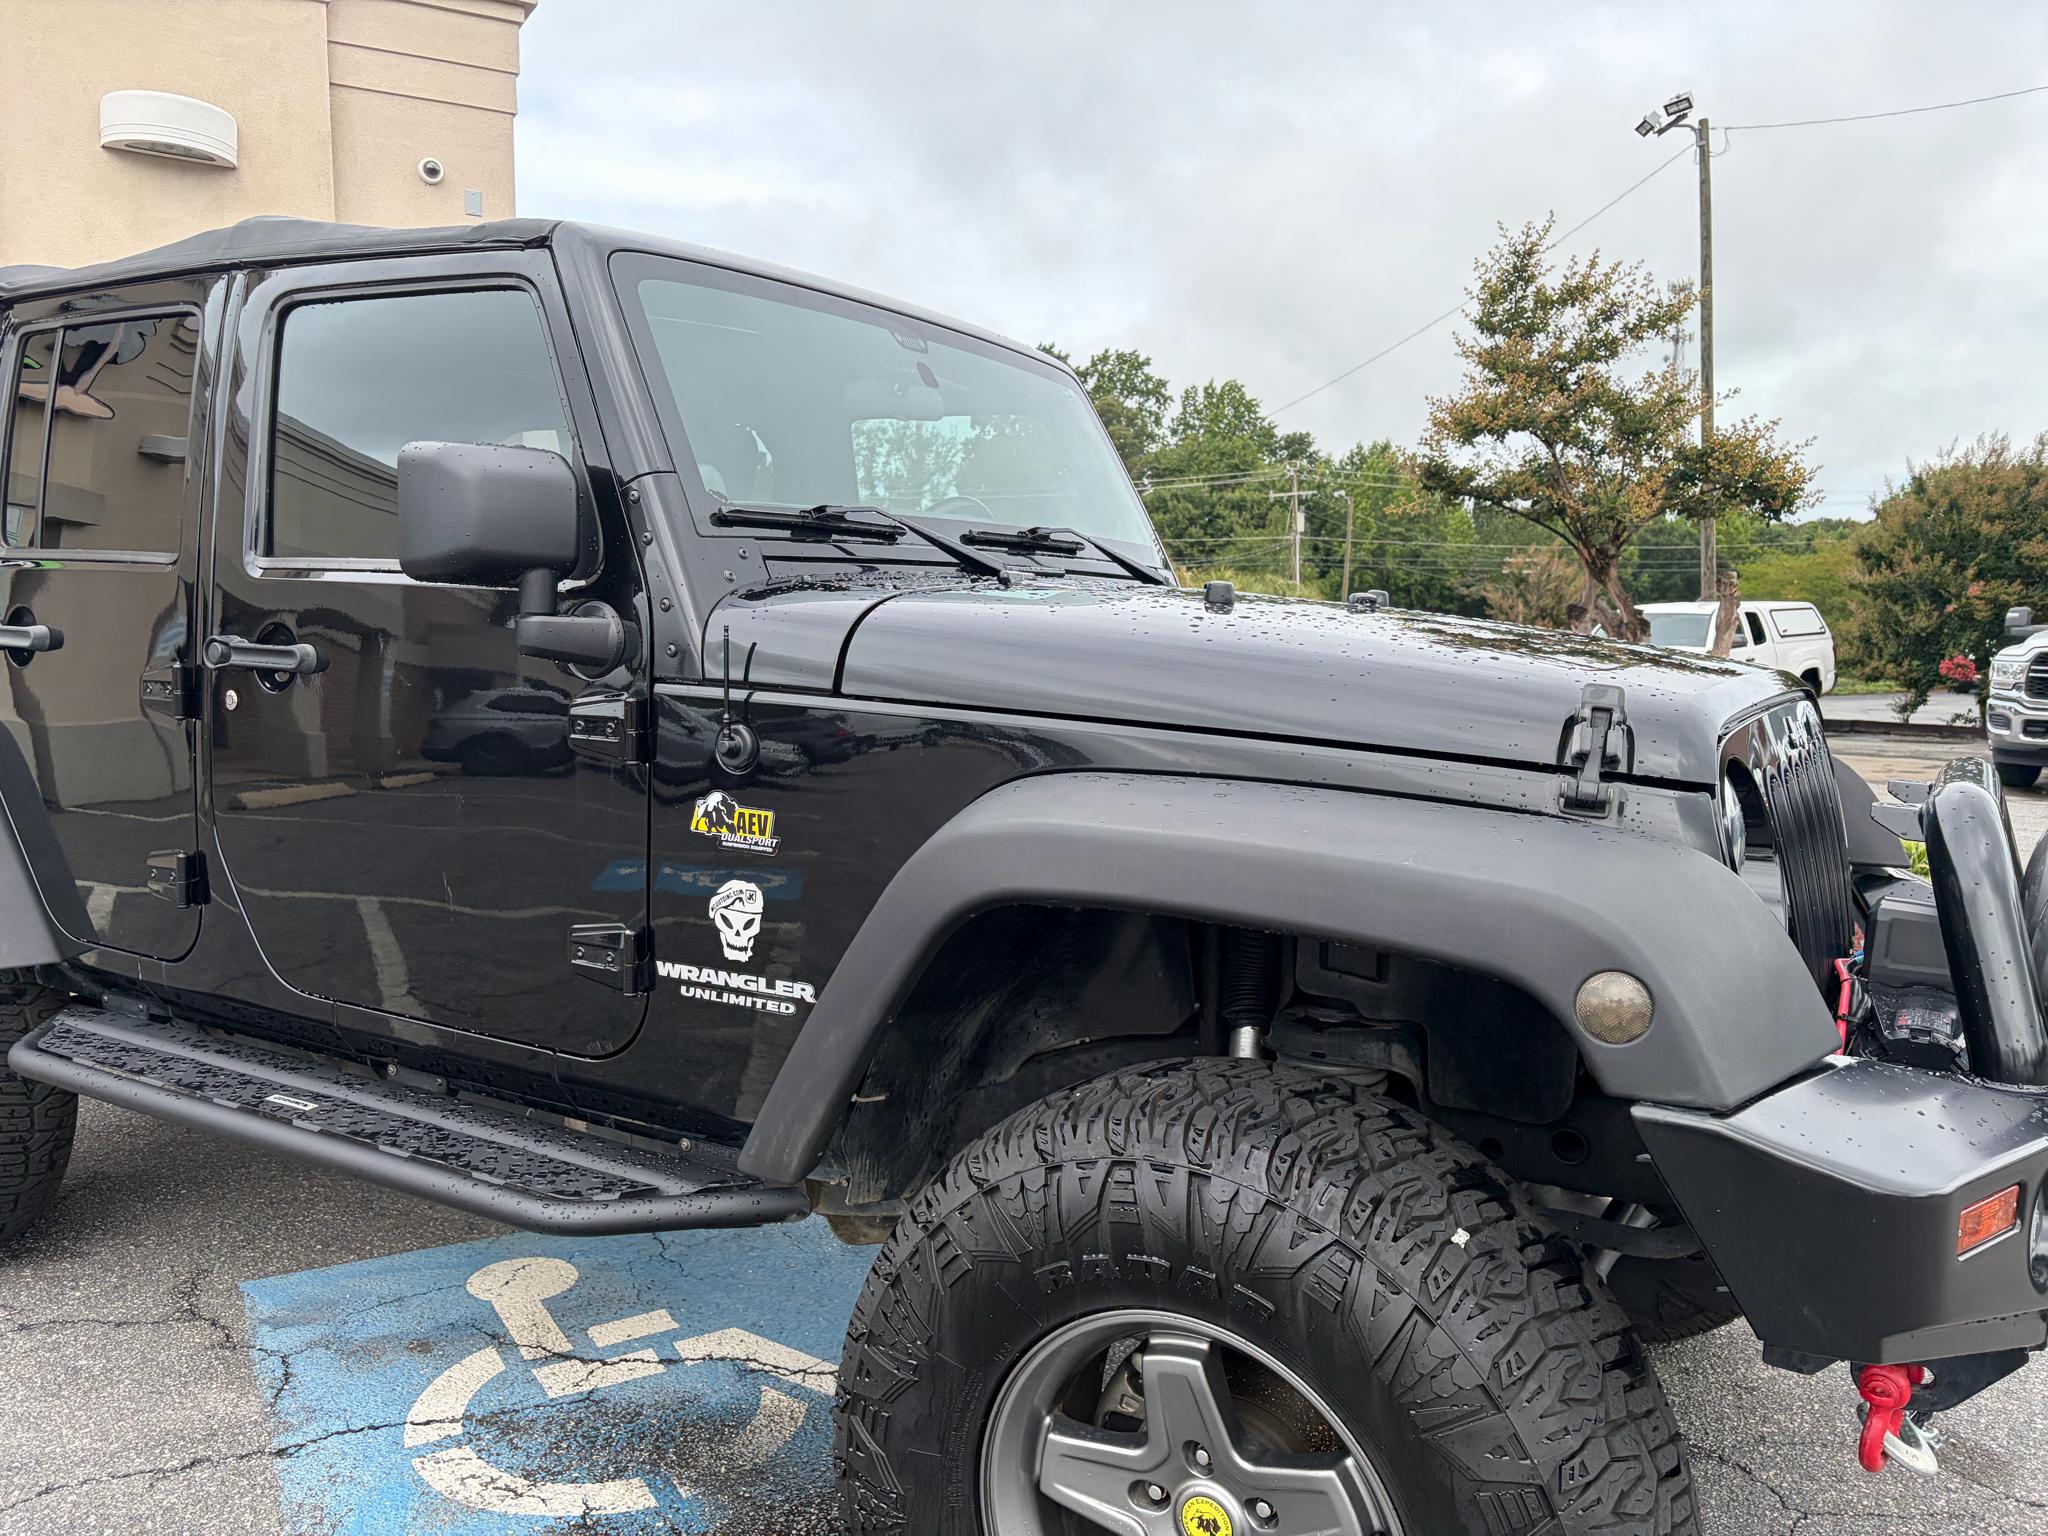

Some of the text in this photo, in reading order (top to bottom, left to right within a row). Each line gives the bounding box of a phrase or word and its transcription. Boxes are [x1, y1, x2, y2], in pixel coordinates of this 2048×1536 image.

[737, 811, 769, 837] AEV
[721, 832, 779, 848] DUALSPORT
[656, 961, 818, 1004] WRANGLER
[680, 985, 797, 1016] UNLIMITED
